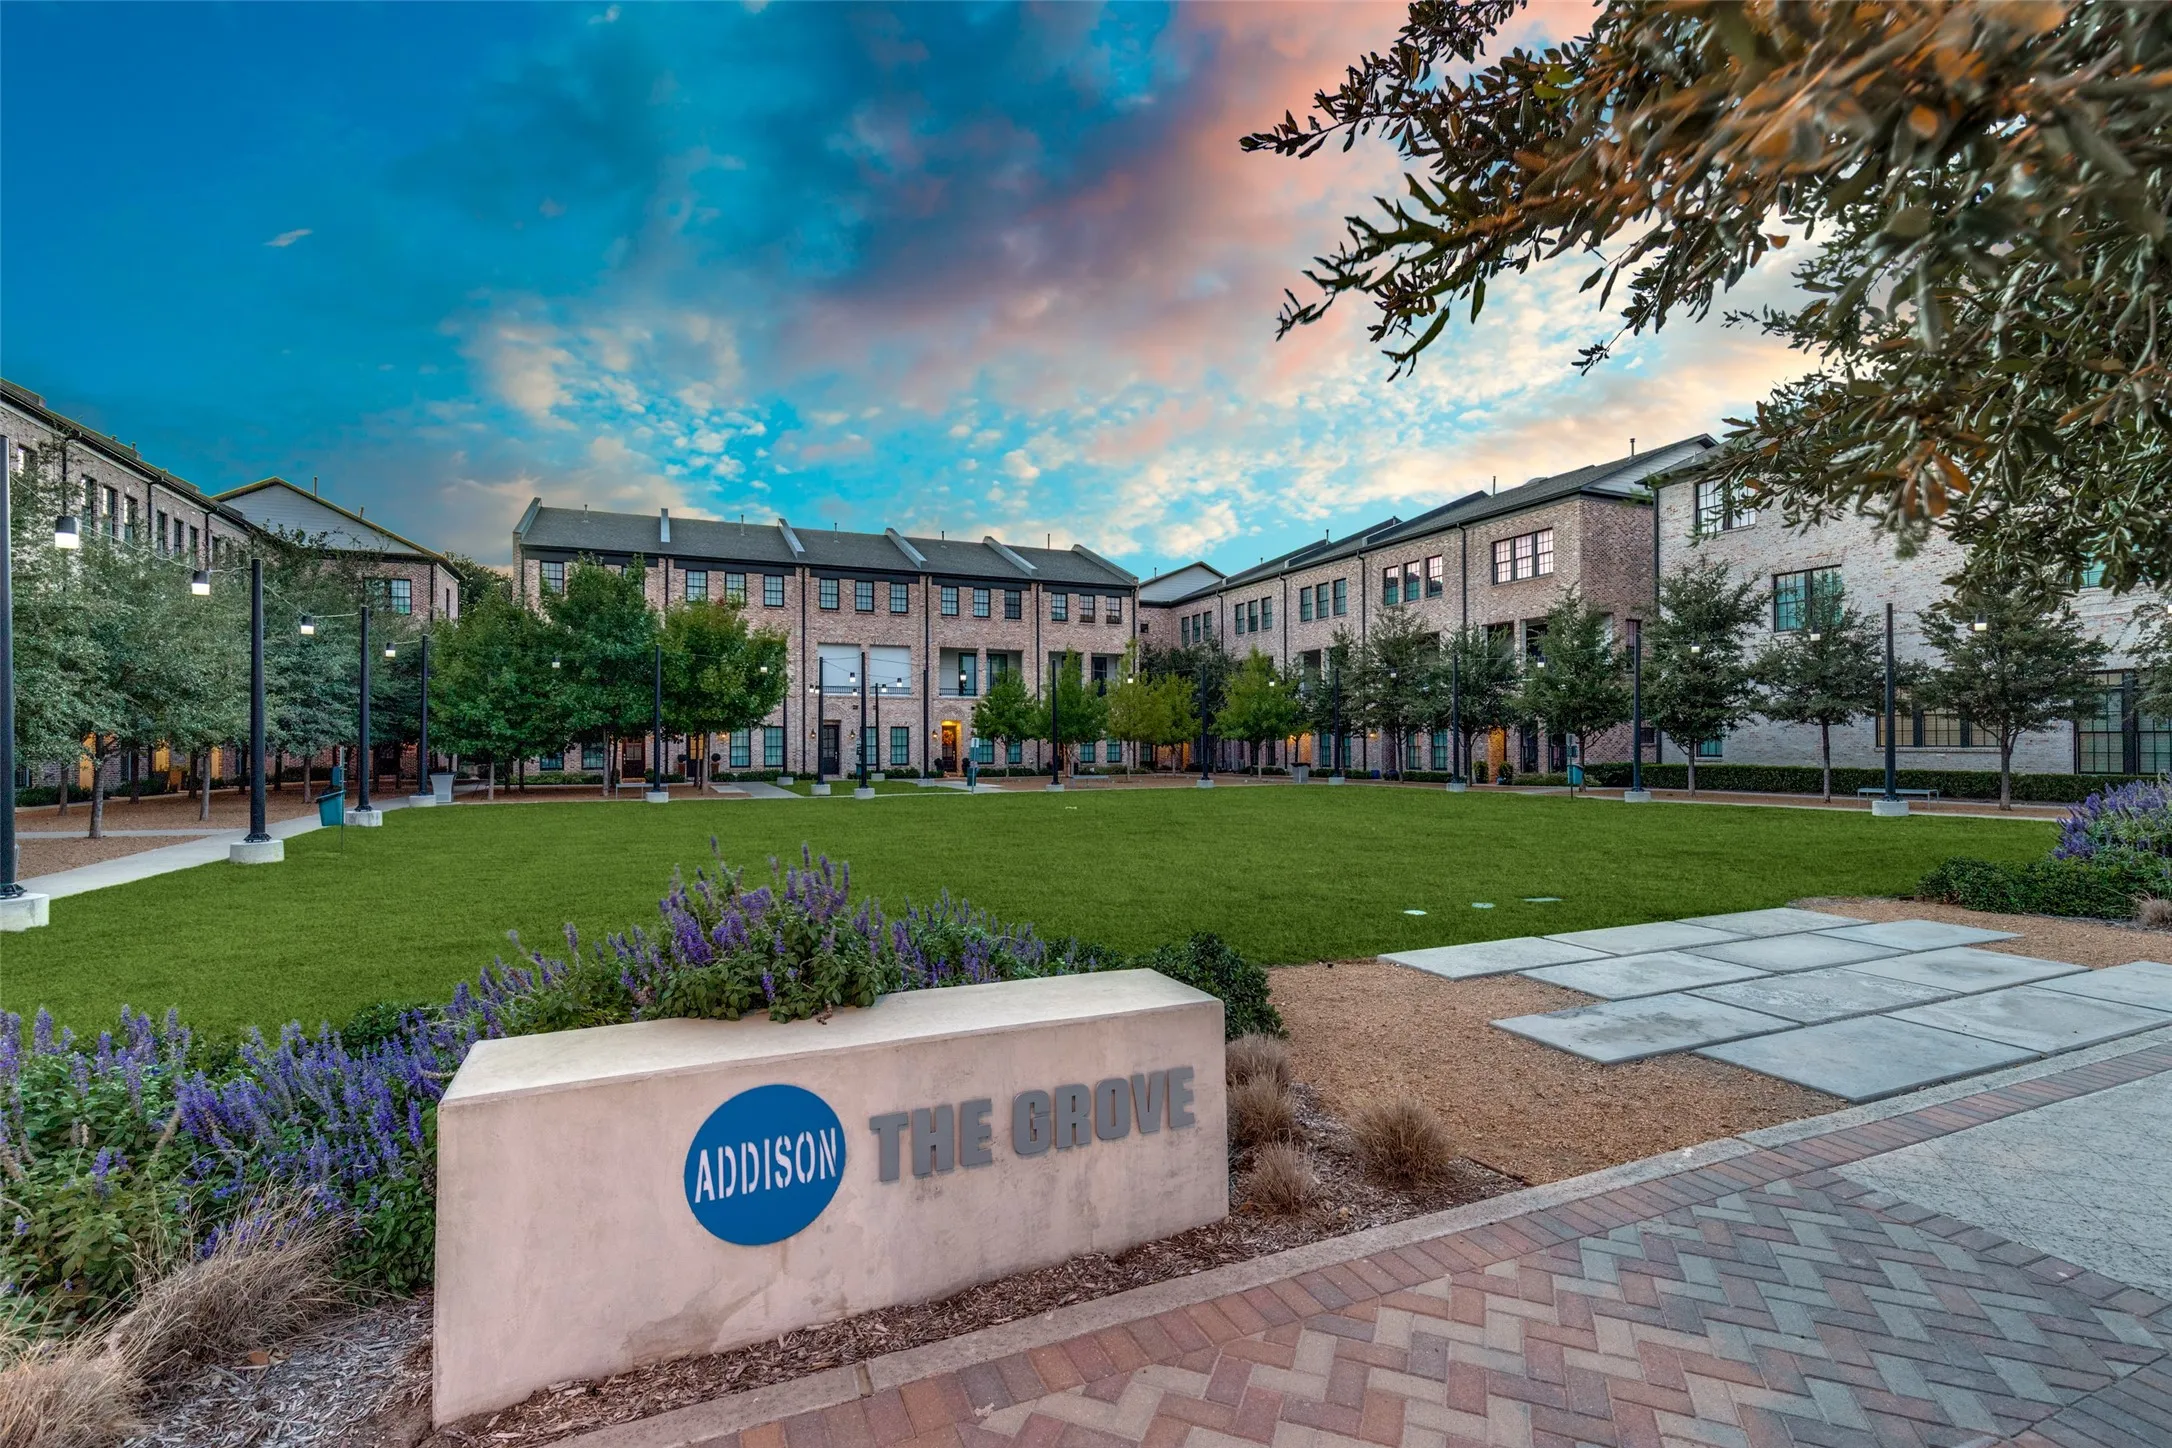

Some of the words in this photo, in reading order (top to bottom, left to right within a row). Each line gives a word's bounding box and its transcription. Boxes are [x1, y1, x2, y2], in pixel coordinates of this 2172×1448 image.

[695, 1127, 837, 1204] ADDISON
[869, 1098, 993, 1182] THE
[1013, 1066, 1195, 1155] GROVE
